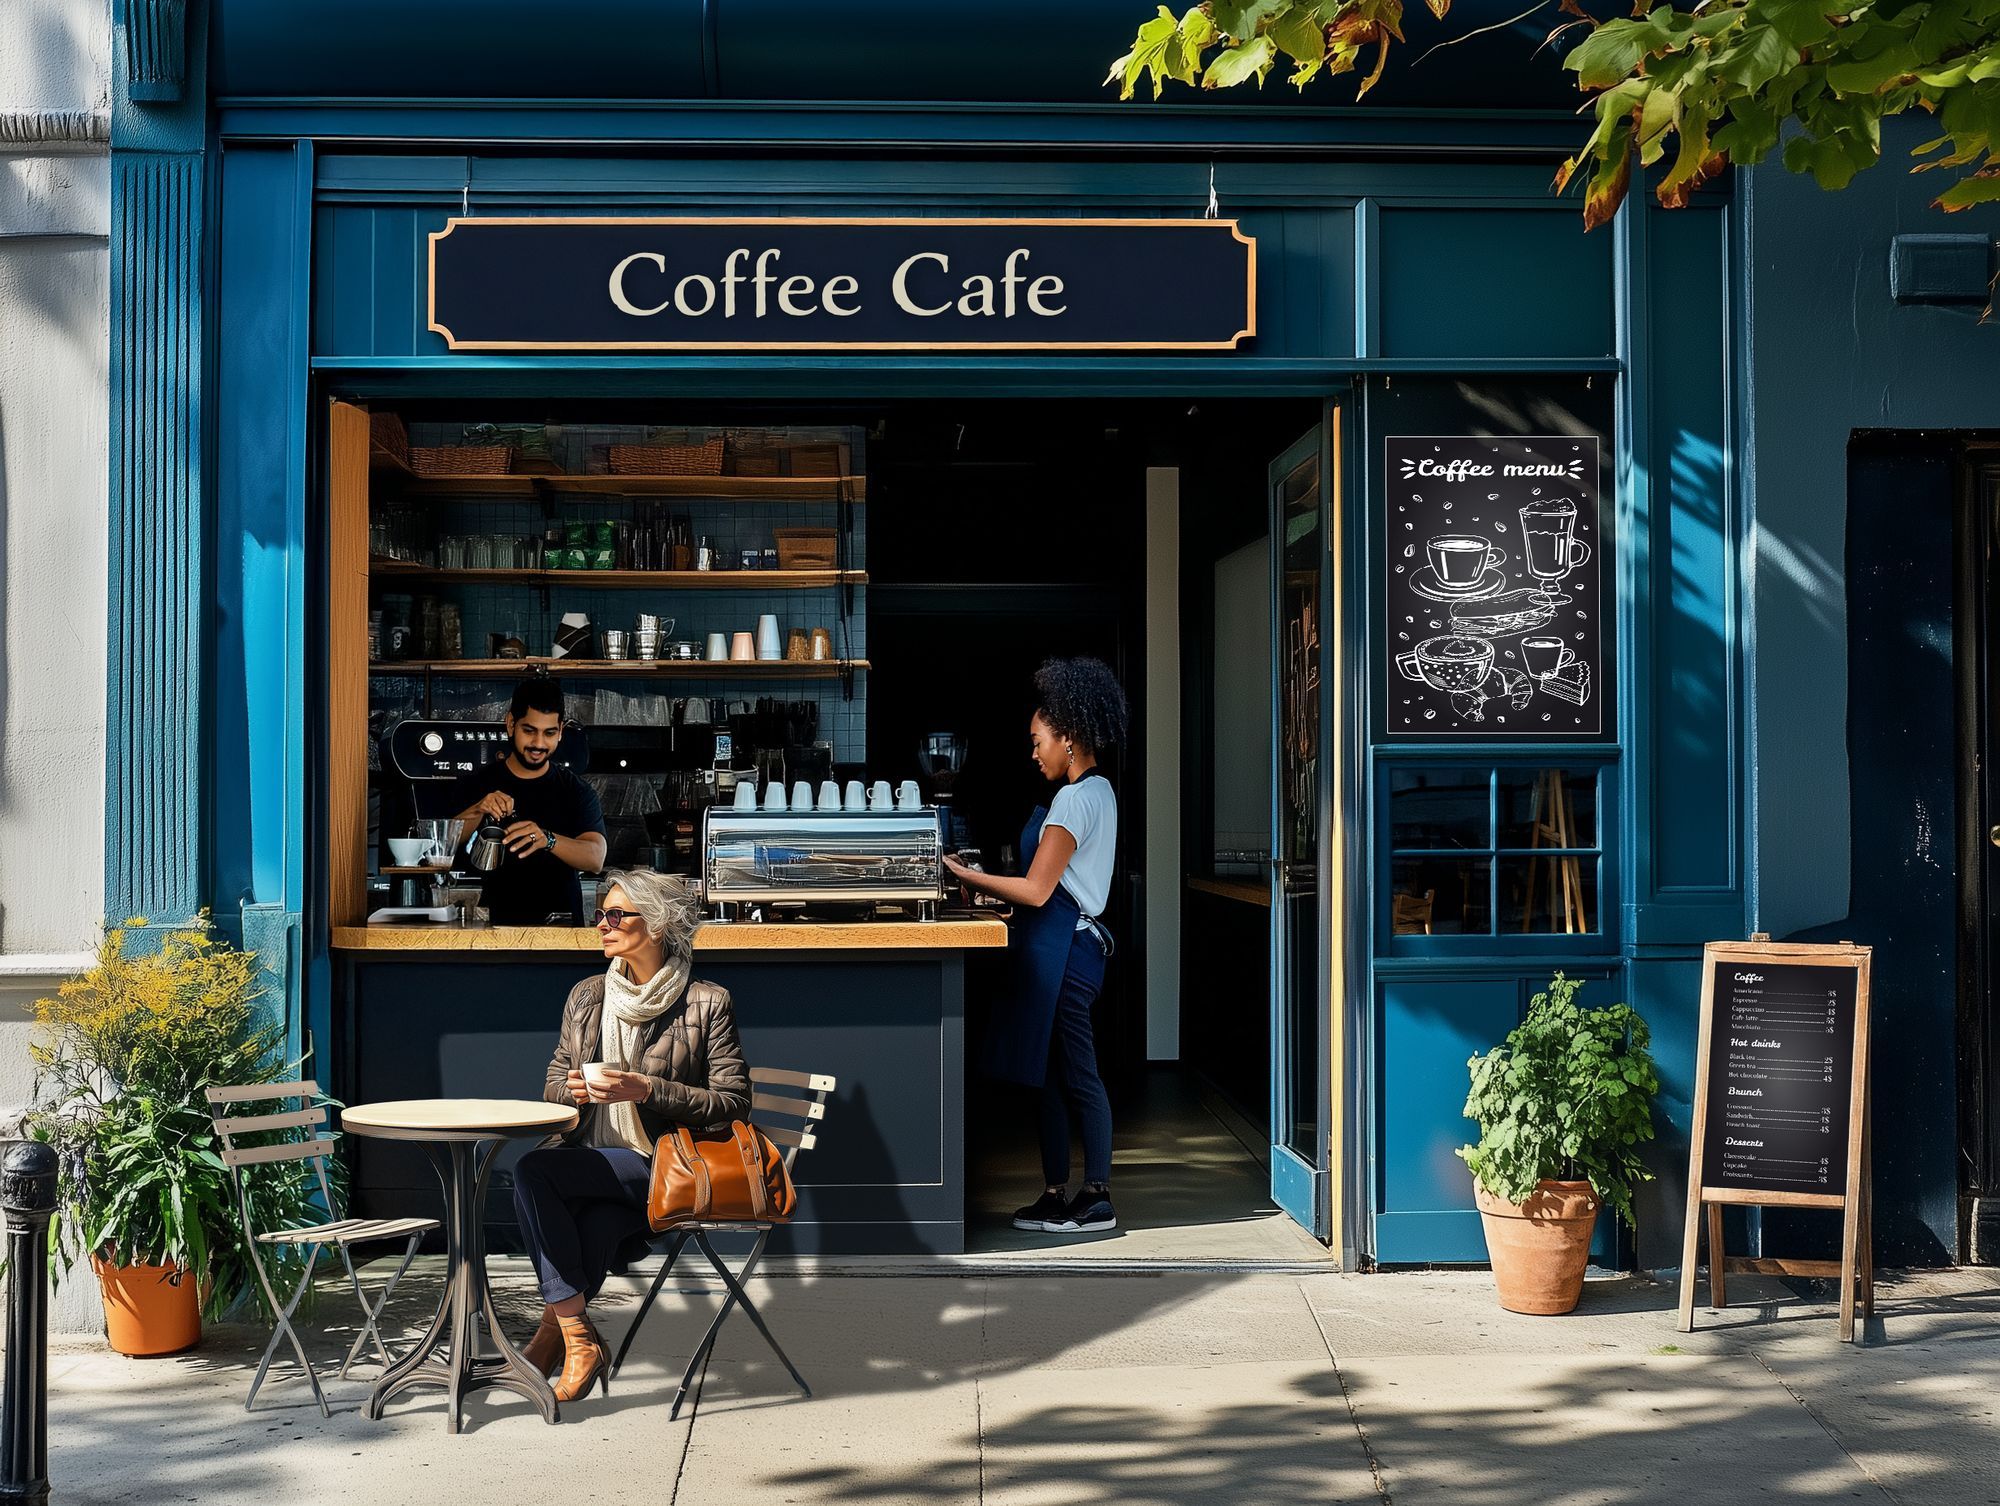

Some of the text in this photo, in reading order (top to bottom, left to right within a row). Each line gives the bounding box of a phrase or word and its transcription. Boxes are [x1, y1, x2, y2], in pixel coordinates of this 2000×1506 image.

[608, 248, 1067, 318] Coffee Cafe
[1418, 459, 1567, 482] Coffee menu
[1734, 972, 1764, 984] Coffee
[1732, 996, 1758, 1004] Espresso
[1731, 1005, 1765, 1013] Cappuccino
[1730, 1037, 1781, 1049] Hot drinks
[1728, 1061, 1746, 1069] Green
[1728, 1086, 1763, 1097] Brunch
[1726, 1111, 1753, 1119] Sandwich
[1725, 1136, 1764, 1148] Desserts
[1723, 1152, 1757, 1160] Cheesecake
[1722, 1161, 1747, 1169] Cupcake
[1722, 1170, 1753, 1178] Croissants
